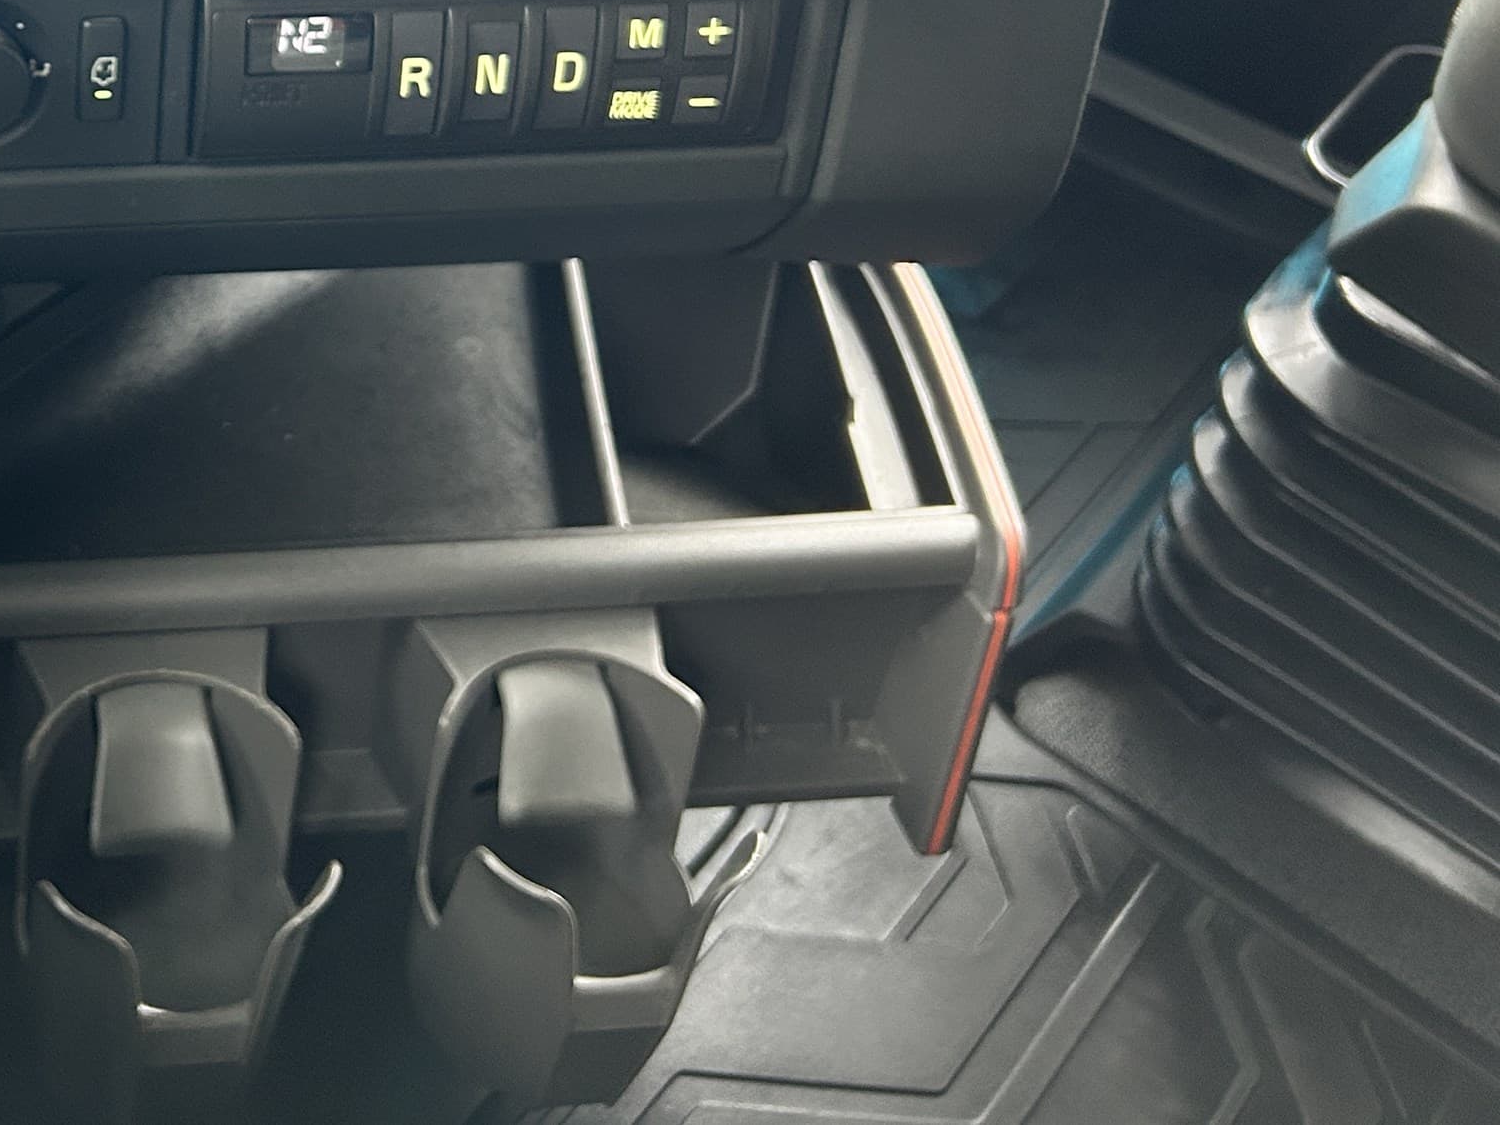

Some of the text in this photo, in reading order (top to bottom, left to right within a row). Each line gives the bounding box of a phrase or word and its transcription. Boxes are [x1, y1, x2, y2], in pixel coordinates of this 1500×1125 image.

[276, 15, 334, 55] N2
[628, 17, 666, 50] M
[399, 56, 434, 99] R
[474, 52, 511, 96] N
[552, 50, 588, 93] D
[608, 103, 661, 120] MODE
[611, 89, 662, 106] DRIVE
